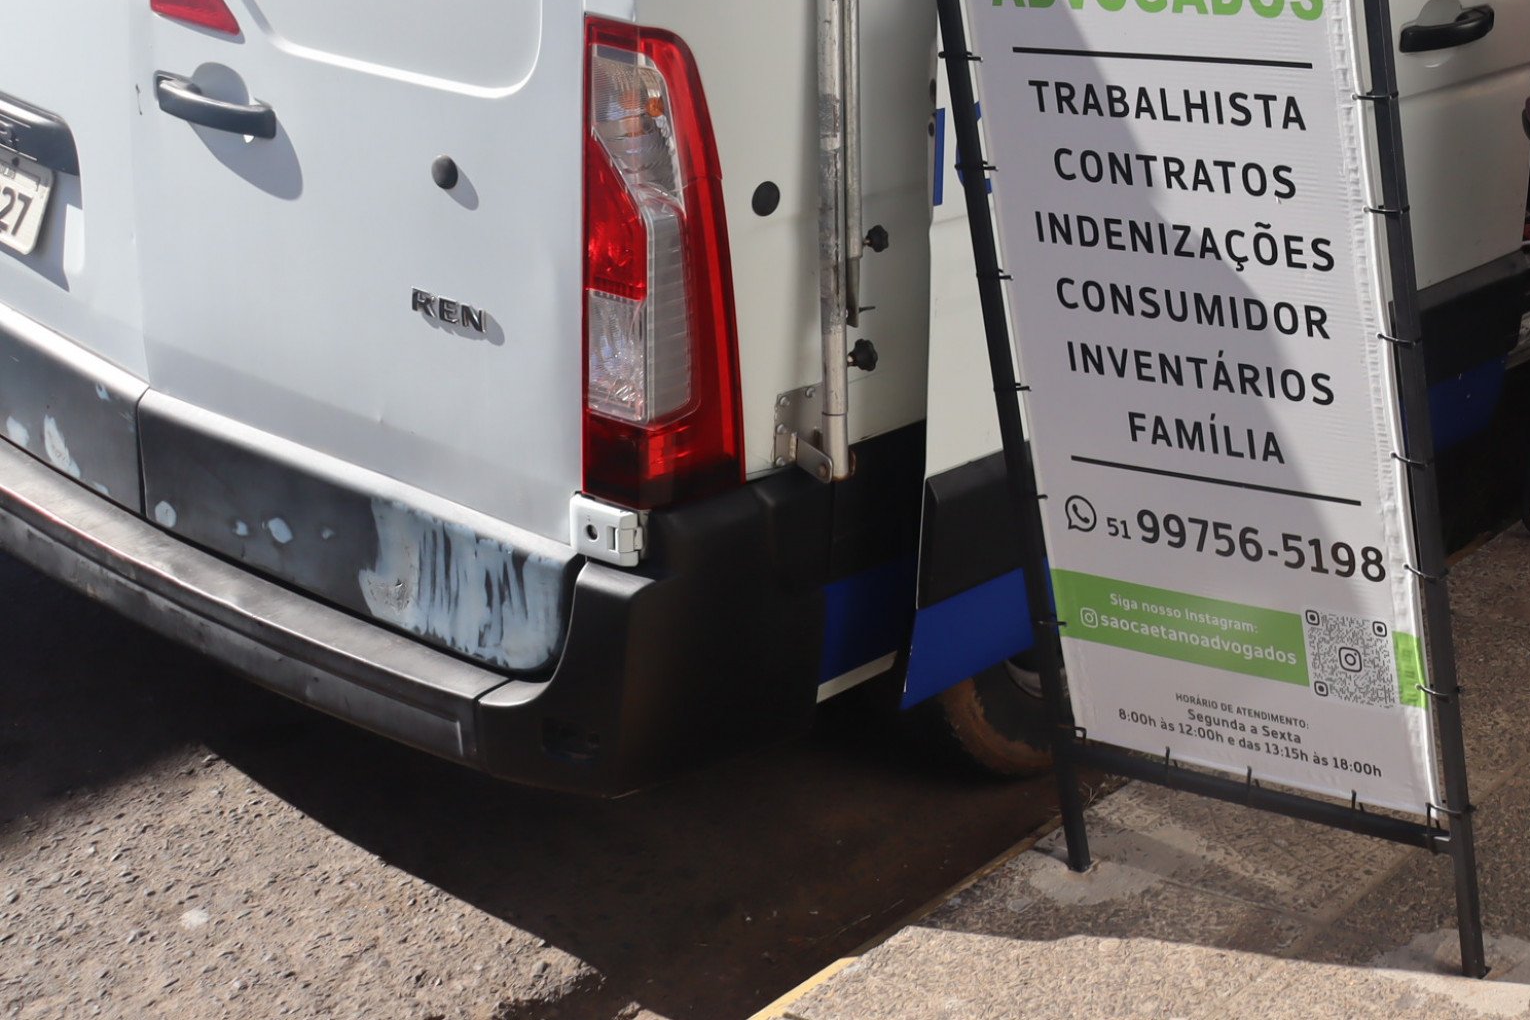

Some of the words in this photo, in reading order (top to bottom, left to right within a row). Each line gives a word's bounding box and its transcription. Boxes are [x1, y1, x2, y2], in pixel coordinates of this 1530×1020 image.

[1029, 80, 1307, 130] TRABALHISTA
[1054, 147, 1296, 200] CONTRATOS
[1035, 210, 1335, 273] INDENIZAÇÕES
[411, 286, 486, 333] REN
[1056, 277, 1331, 340] CONSUMIDOR
[1067, 340, 1335, 407] INVENTÁRIOS
[1128, 411, 1286, 464] FAMÍLIA
[1107, 516, 1132, 540] 51
[1137, 508, 1387, 583] 99756-5198
[1100, 613, 1298, 665] saocaetanoadvogados
[1110, 593, 1139, 611] Siga
[1141, 600, 1182, 619] nosso
[1185, 608, 1259, 634] Instagram:
[1175, 692, 1218, 710] HORÁRIO
[1220, 702, 1234, 714] DE
[1236, 706, 1310, 730] ATENDIMENTO:
[1187, 708, 1246, 733] Segunda
[1250, 724, 1258, 735] a
[1262, 724, 1302, 744] Sexta
[1118, 708, 1157, 728] 8:00h
[1160, 717, 1175, 732] às
[1179, 722, 1225, 744] 12:00h
[1227, 735, 1236, 746] e
[1238, 737, 1261, 752] das
[1264, 742, 1309, 763] 13:15h
[1312, 751, 1329, 766] às
[1332, 757, 1382, 778] 18:00h
